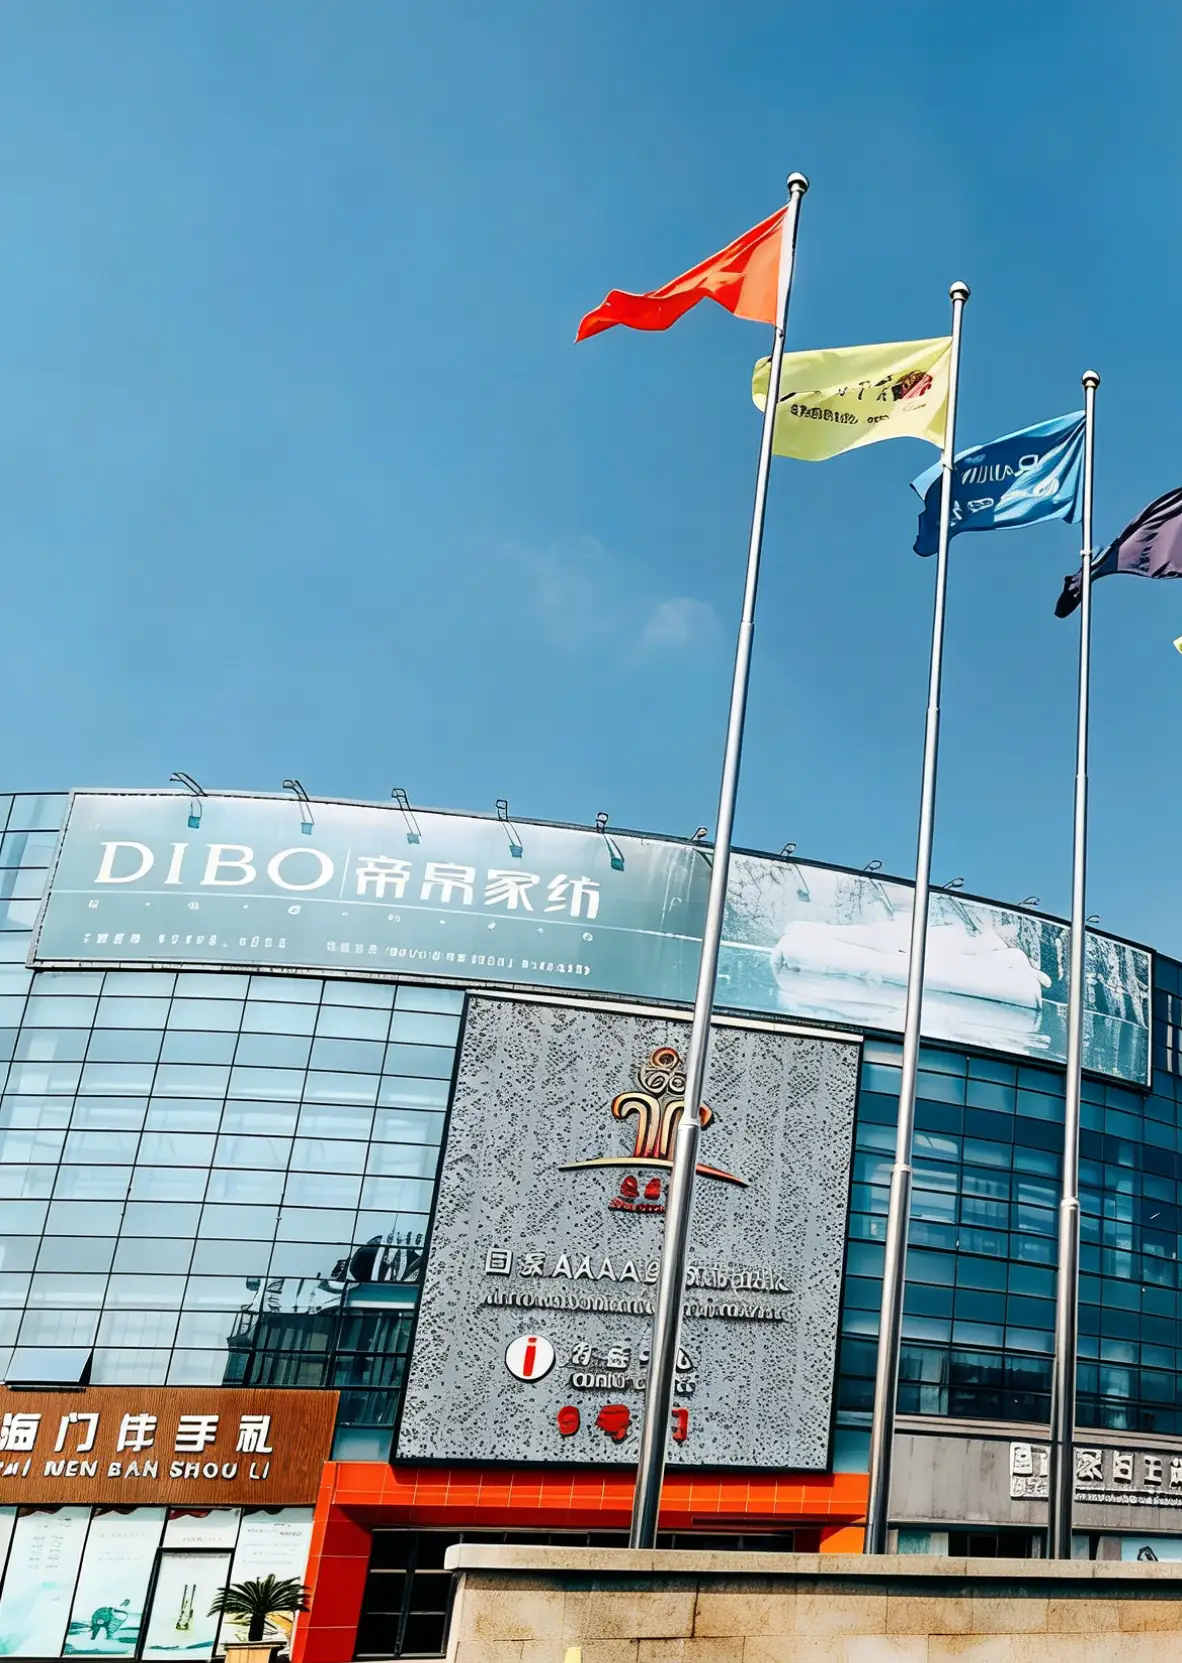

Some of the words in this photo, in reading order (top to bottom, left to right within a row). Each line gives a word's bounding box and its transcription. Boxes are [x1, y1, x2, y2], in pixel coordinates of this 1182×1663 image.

[94, 840, 334, 891] DIBO
[107, 1459, 159, 1479] BAN
[169, 1460, 238, 1480] SHOU
[249, 1461, 270, 1480] LI
